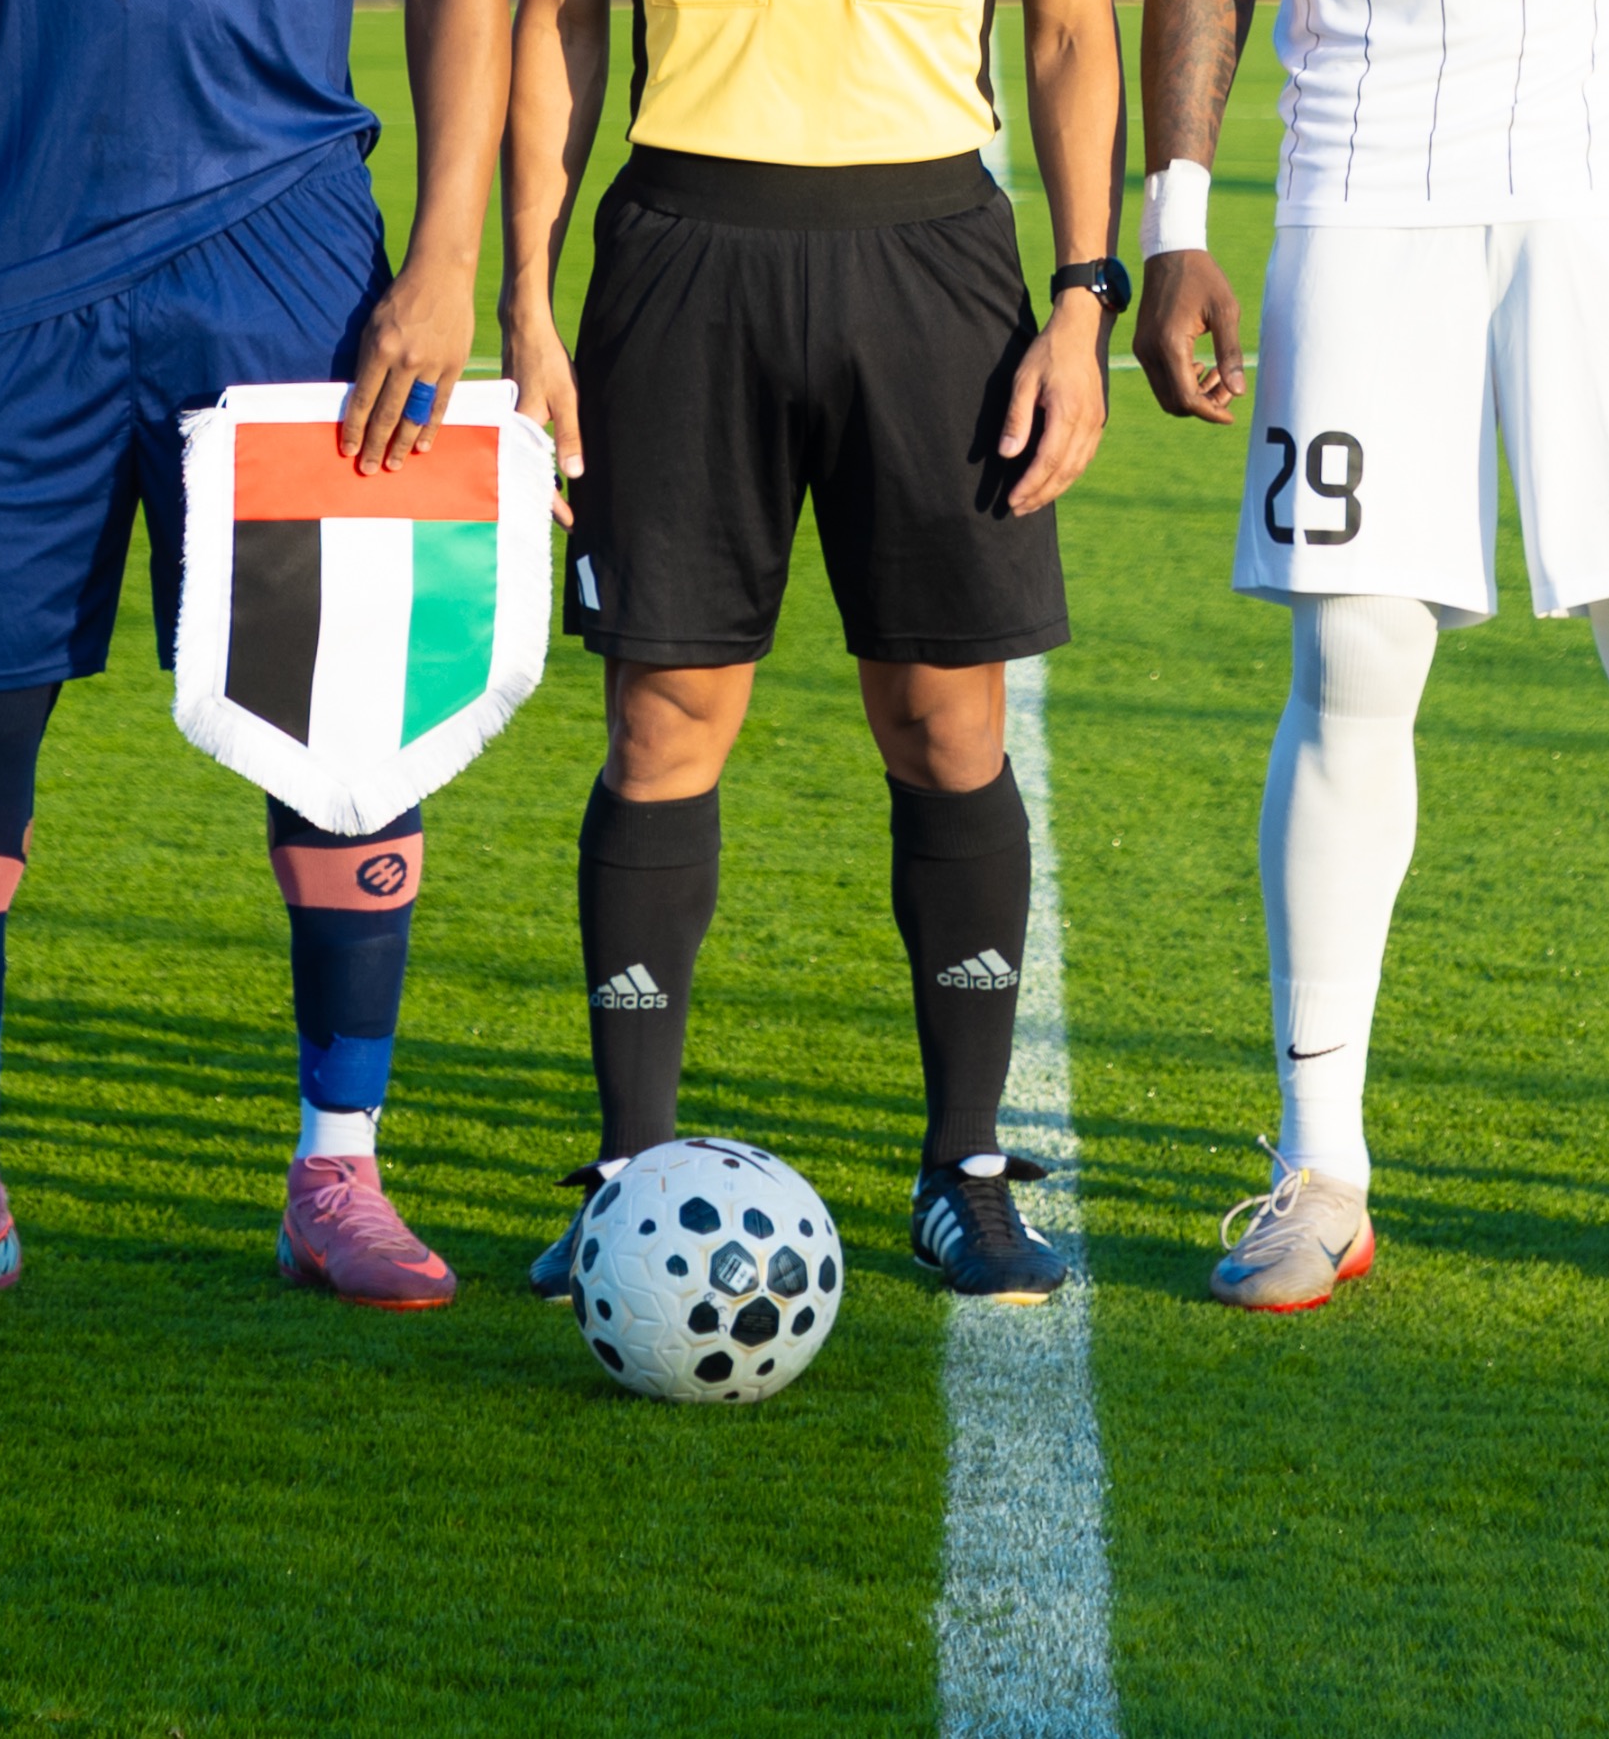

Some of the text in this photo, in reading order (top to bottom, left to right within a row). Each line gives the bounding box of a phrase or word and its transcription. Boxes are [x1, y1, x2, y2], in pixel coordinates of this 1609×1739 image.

[1264, 426, 1363, 545] 29
[936, 970, 1018, 991] adidas
[590, 991, 669, 1010] adidas
